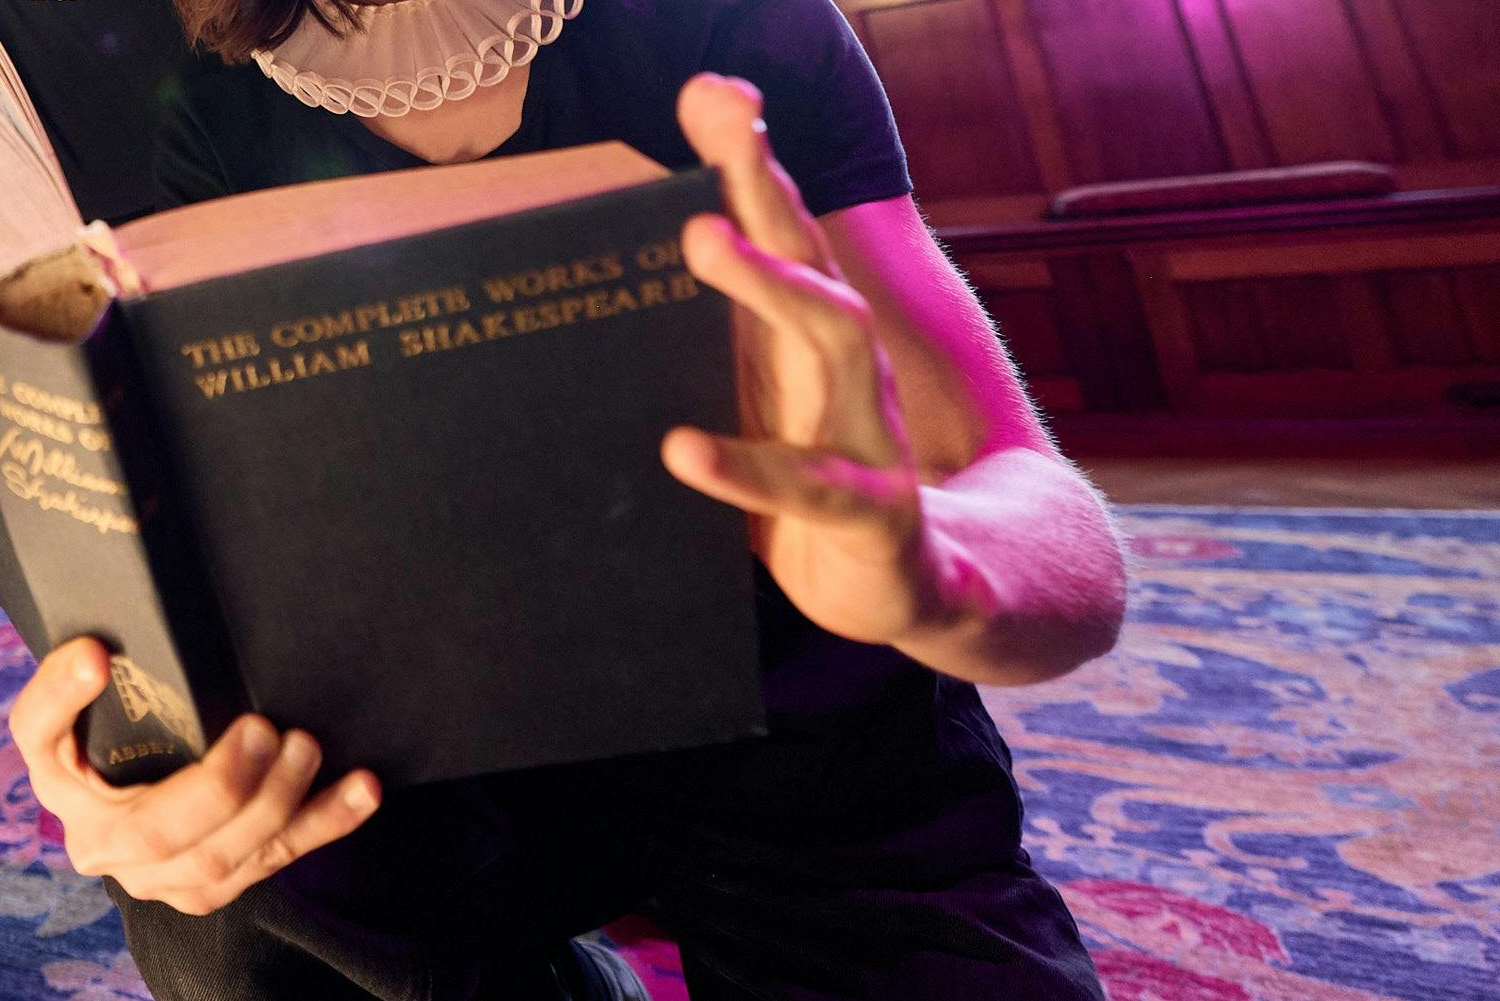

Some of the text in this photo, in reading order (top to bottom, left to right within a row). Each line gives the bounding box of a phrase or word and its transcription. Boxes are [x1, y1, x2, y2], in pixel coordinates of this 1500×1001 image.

[182, 331, 260, 368] THE
[270, 287, 470, 346] COMPLETE
[484, 254, 623, 303] WORKS
[196, 271, 699, 399] WILLIAM SHAKESPEARE
